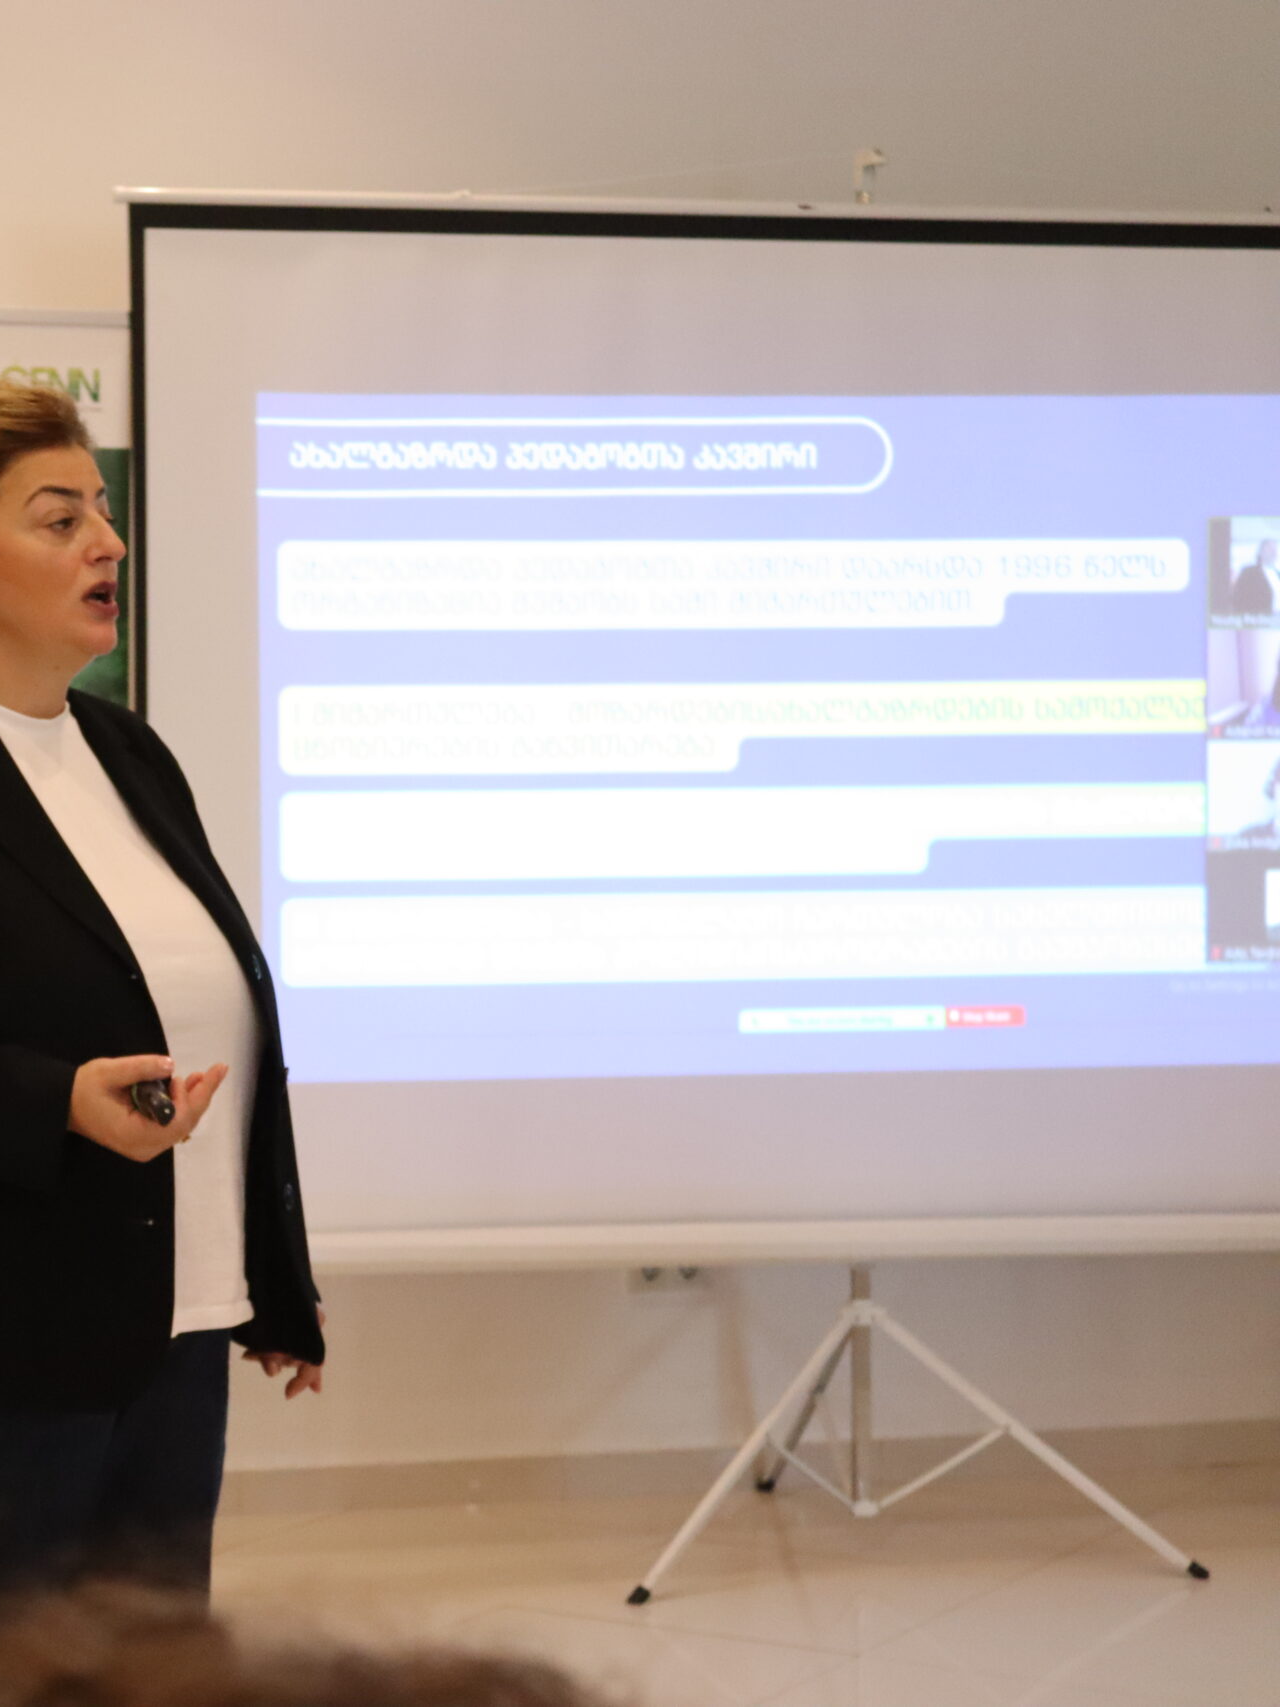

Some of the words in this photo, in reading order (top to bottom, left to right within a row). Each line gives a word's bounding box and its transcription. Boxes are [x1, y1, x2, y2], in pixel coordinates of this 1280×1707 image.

[289, 441, 497, 470] ახალგაზრდა
[505, 441, 686, 470] პედაგოგთა
[693, 442, 819, 470] კავშირი
[999, 554, 1072, 578] 1996
[1081, 553, 1167, 580] წელს
